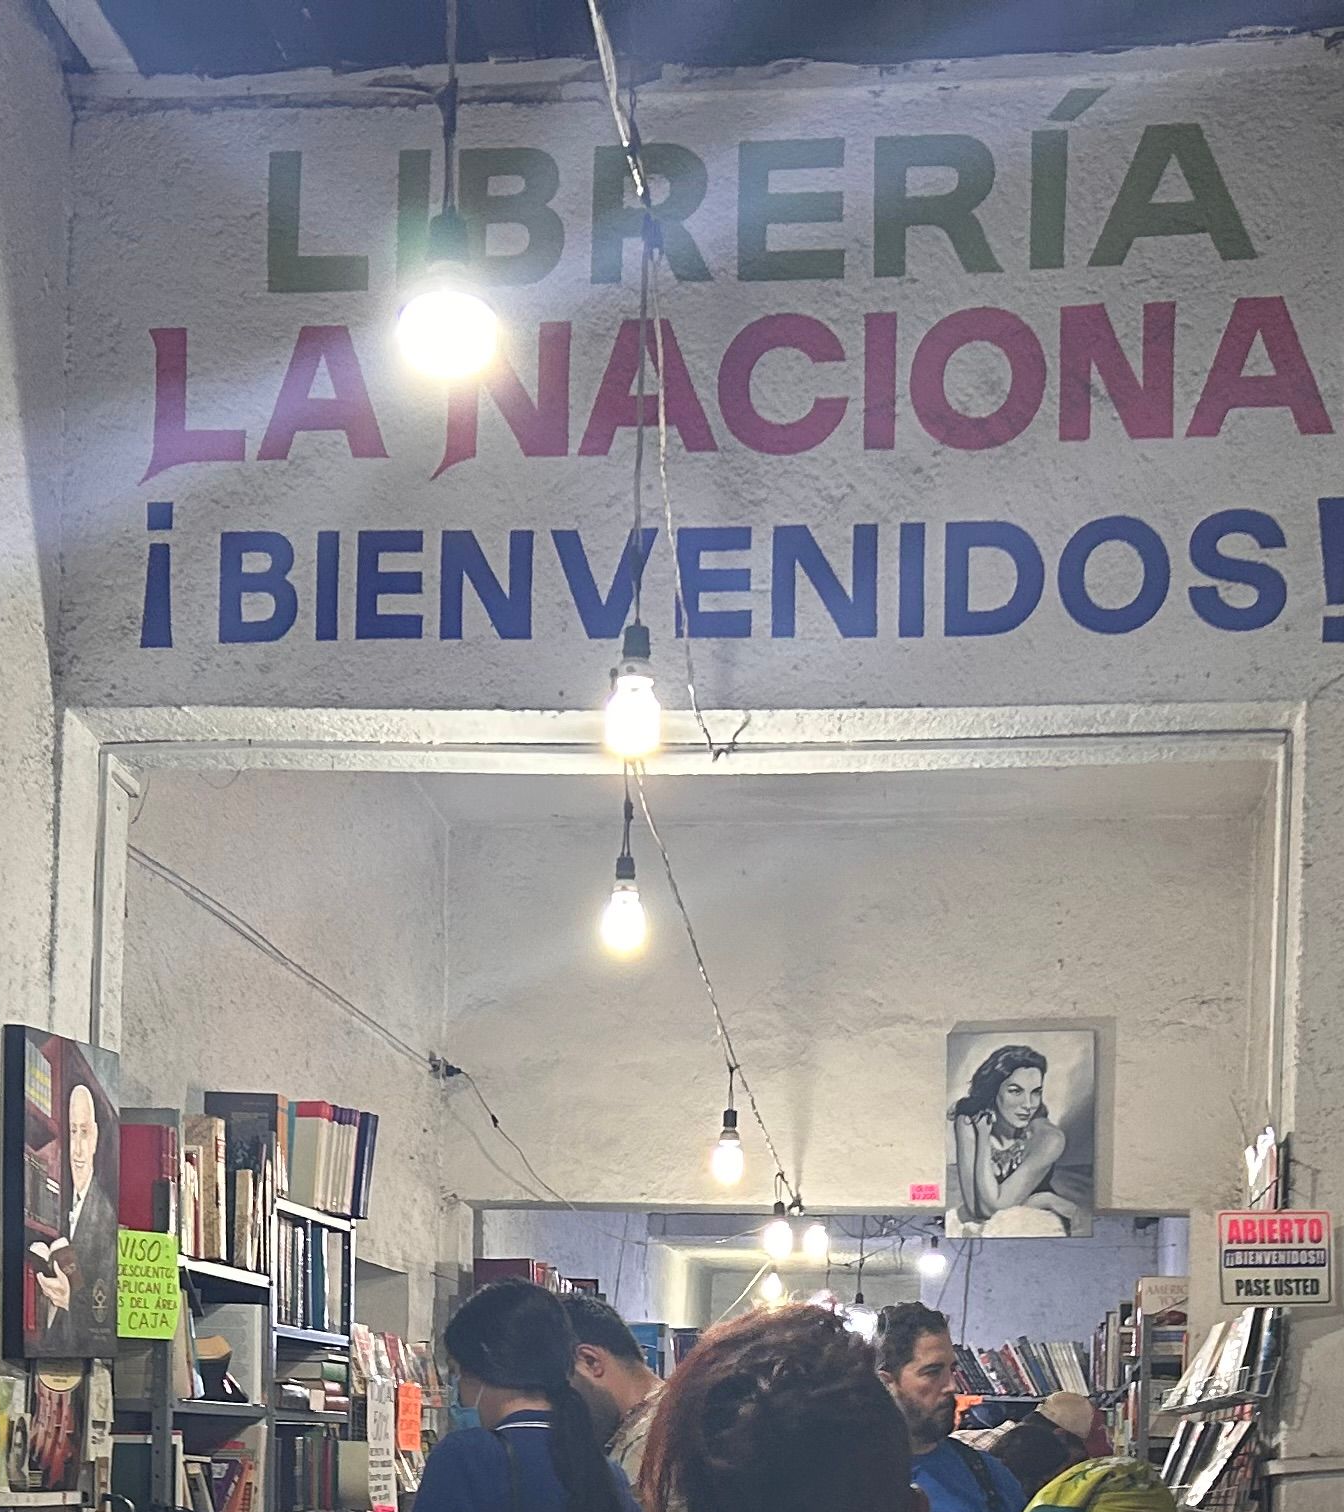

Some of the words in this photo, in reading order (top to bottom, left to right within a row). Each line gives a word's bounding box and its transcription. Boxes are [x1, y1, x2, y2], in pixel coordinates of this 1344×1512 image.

[268, 88, 1256, 294] LIBRERÍA
[141, 325, 388, 485] LA
[1228, 1218, 1323, 1244] ABIERTO
[1236, 1278, 1271, 1296] PASE
[1274, 1278, 1320, 1296] USTED
[128, 1311, 173, 1330] CAJA
